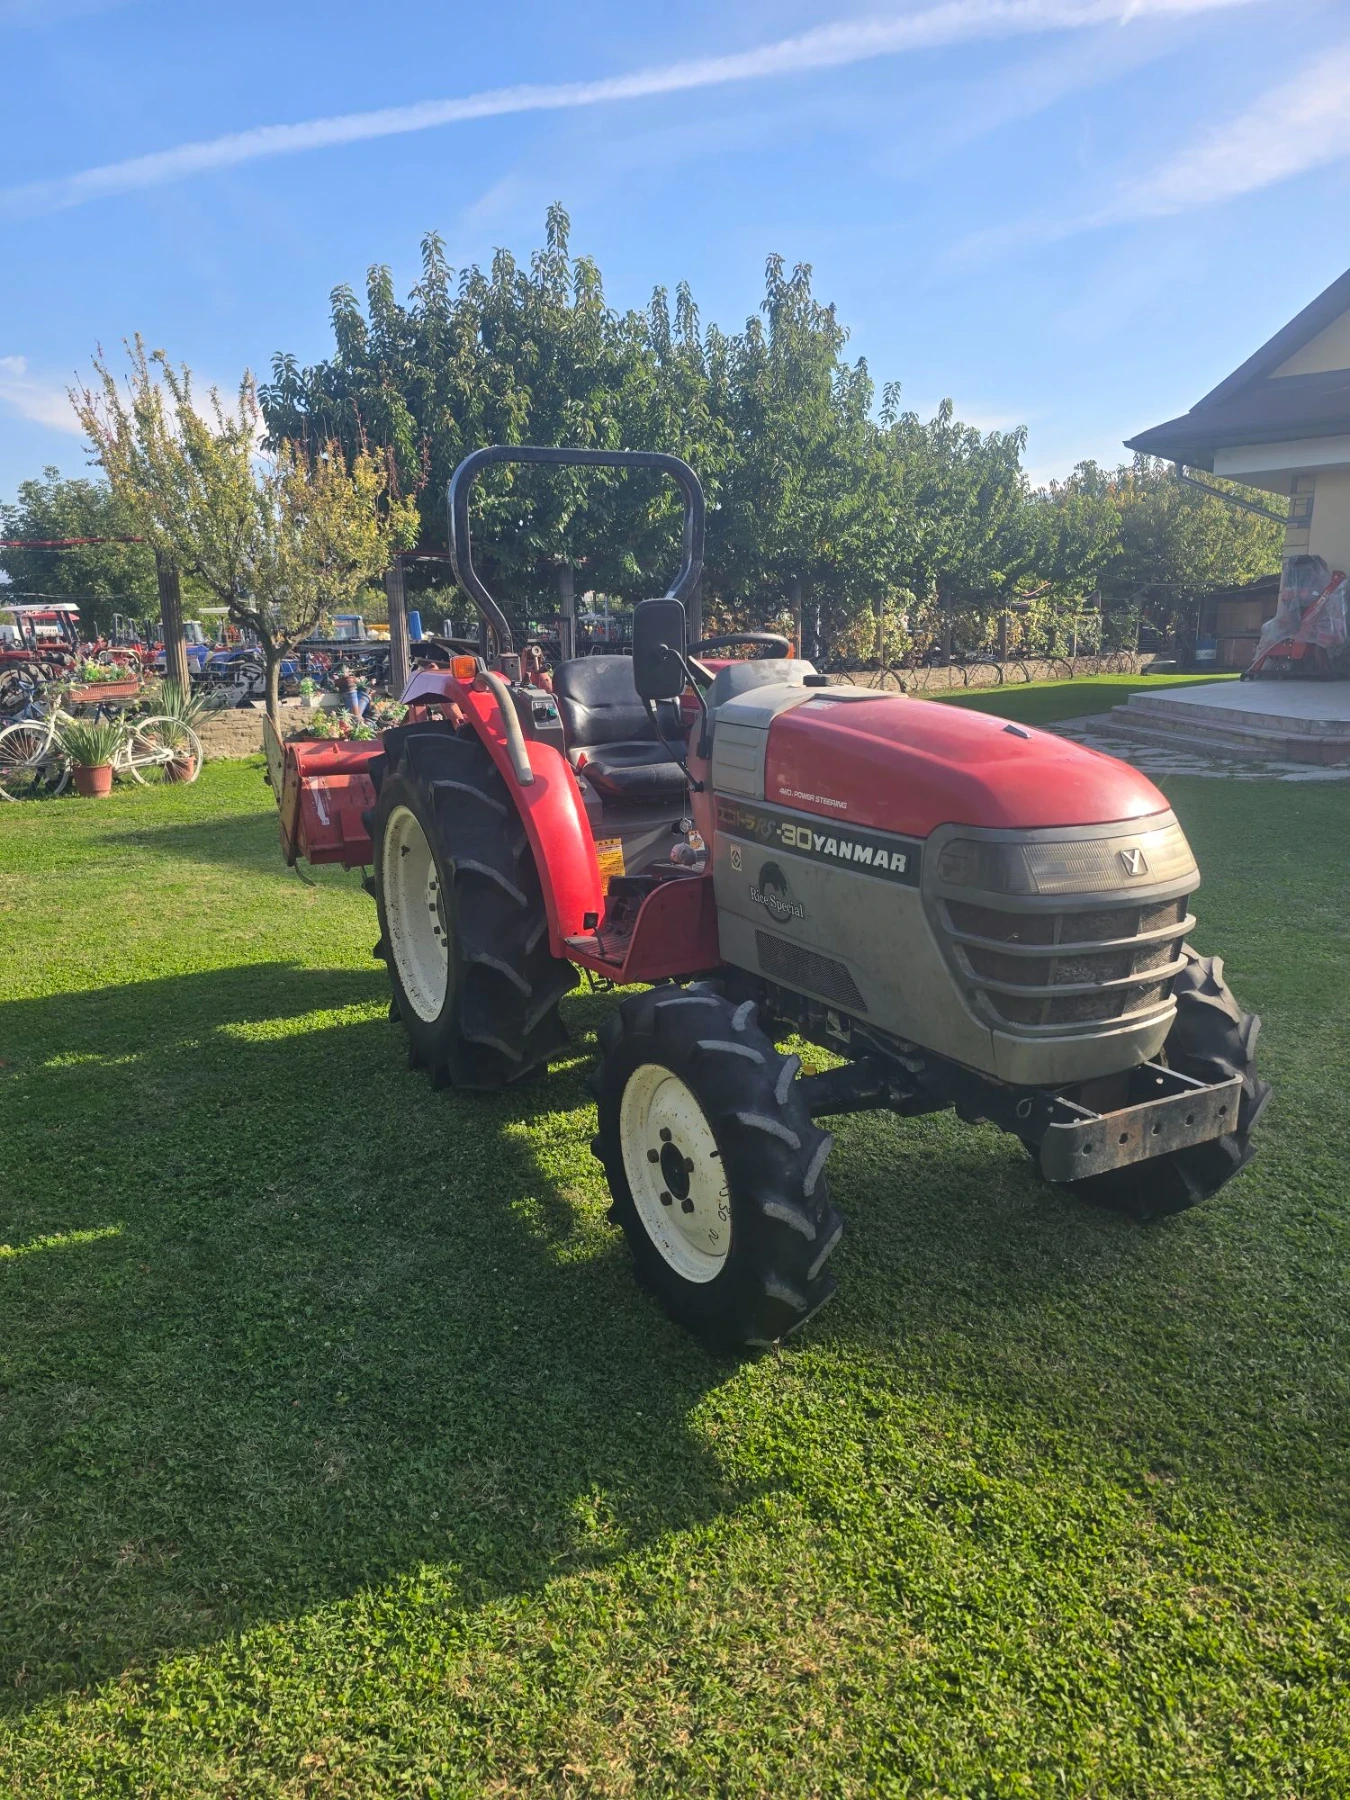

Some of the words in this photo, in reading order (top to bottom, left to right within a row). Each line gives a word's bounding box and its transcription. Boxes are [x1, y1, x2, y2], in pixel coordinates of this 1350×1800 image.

[794, 790, 815, 802] POWER
[815, 795, 848, 809] STEERING
[812, 833, 907, 873] YANMAR
[749, 886, 769, 906] Rice
[769, 894, 804, 918] Special
